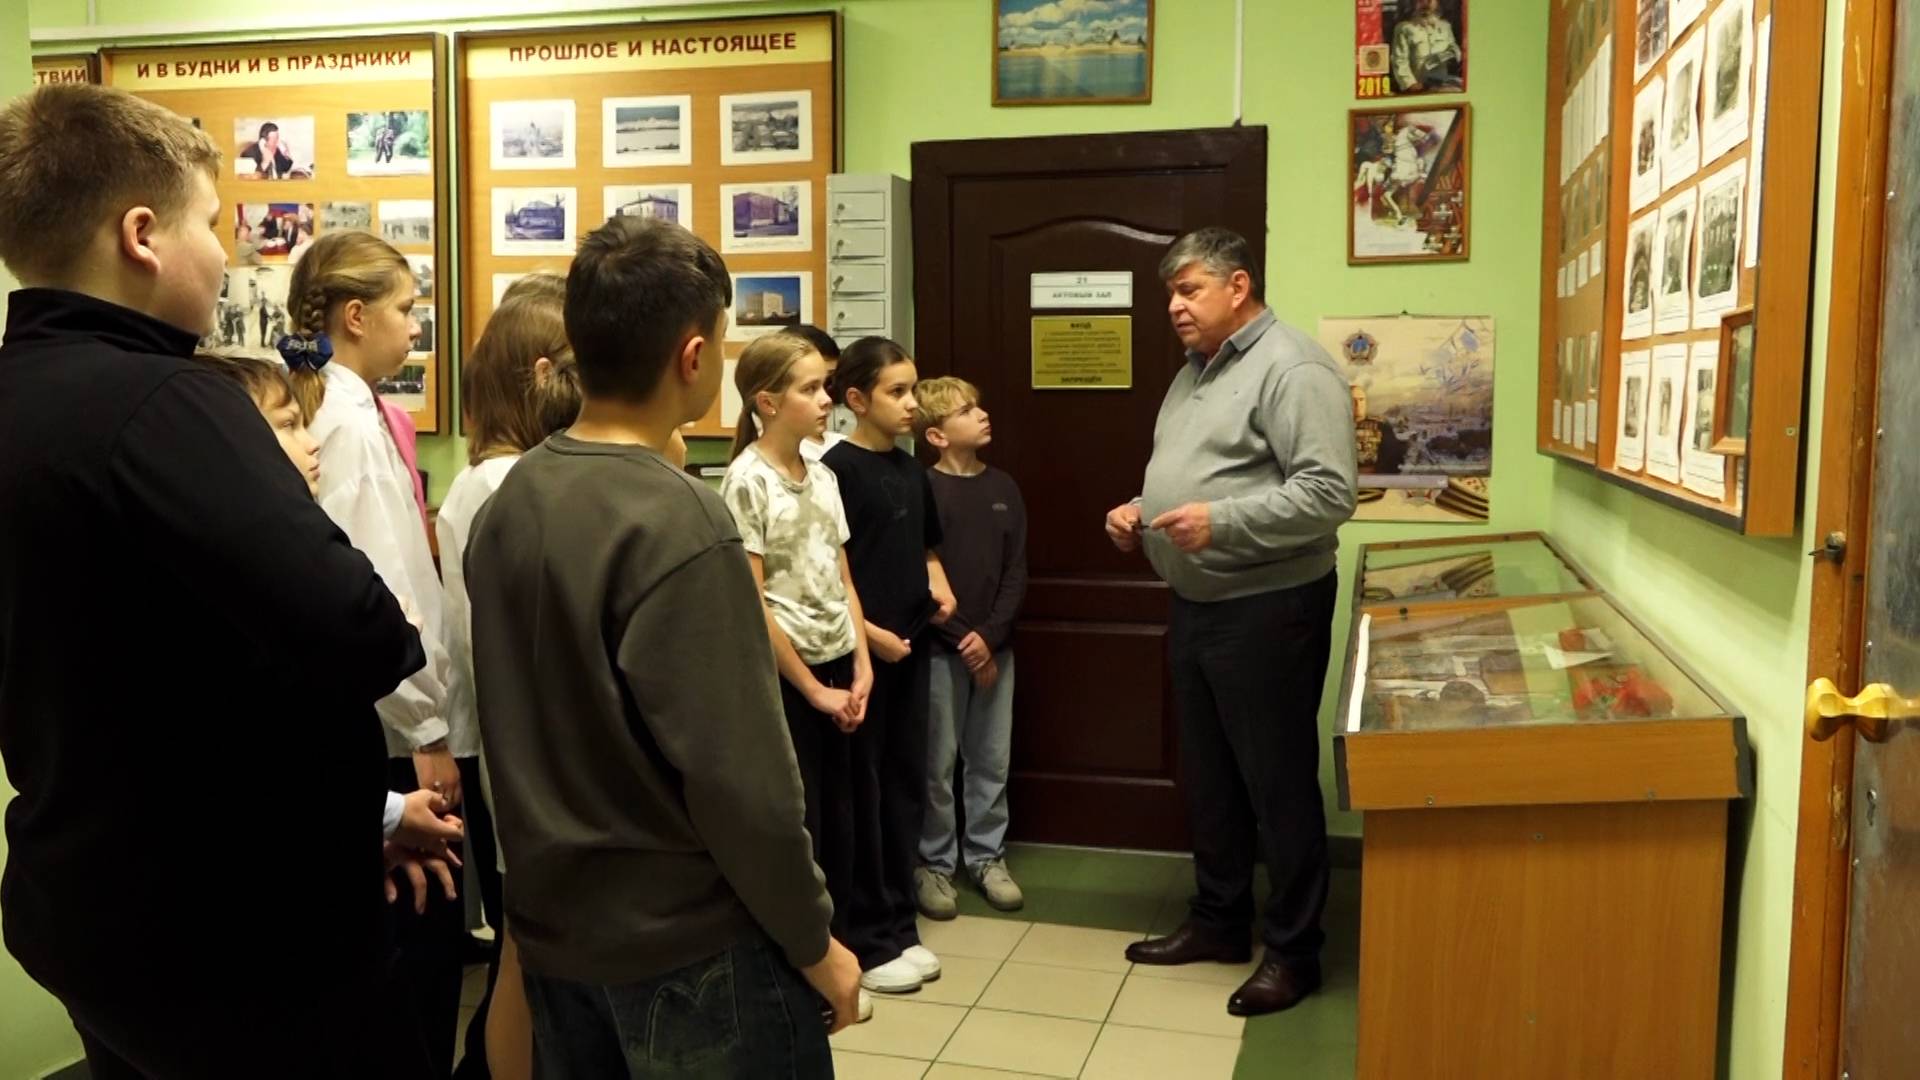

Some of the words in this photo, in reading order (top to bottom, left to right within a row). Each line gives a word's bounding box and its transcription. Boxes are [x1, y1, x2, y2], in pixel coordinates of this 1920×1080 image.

[509, 42, 618, 61] ПРОШЛОЕ
[628, 40, 642, 57] И
[652, 32, 796, 55] НАСТОЯЩЕЕ
[137, 63, 150, 79] И
[156, 62, 169, 78] В
[175, 58, 240, 78] БУДНИ
[248, 57, 261, 73] И
[268, 56, 280, 72] В
[287, 51, 411, 70] ПРАЗДНИКИ
[1358, 77, 1391, 96] 2019
